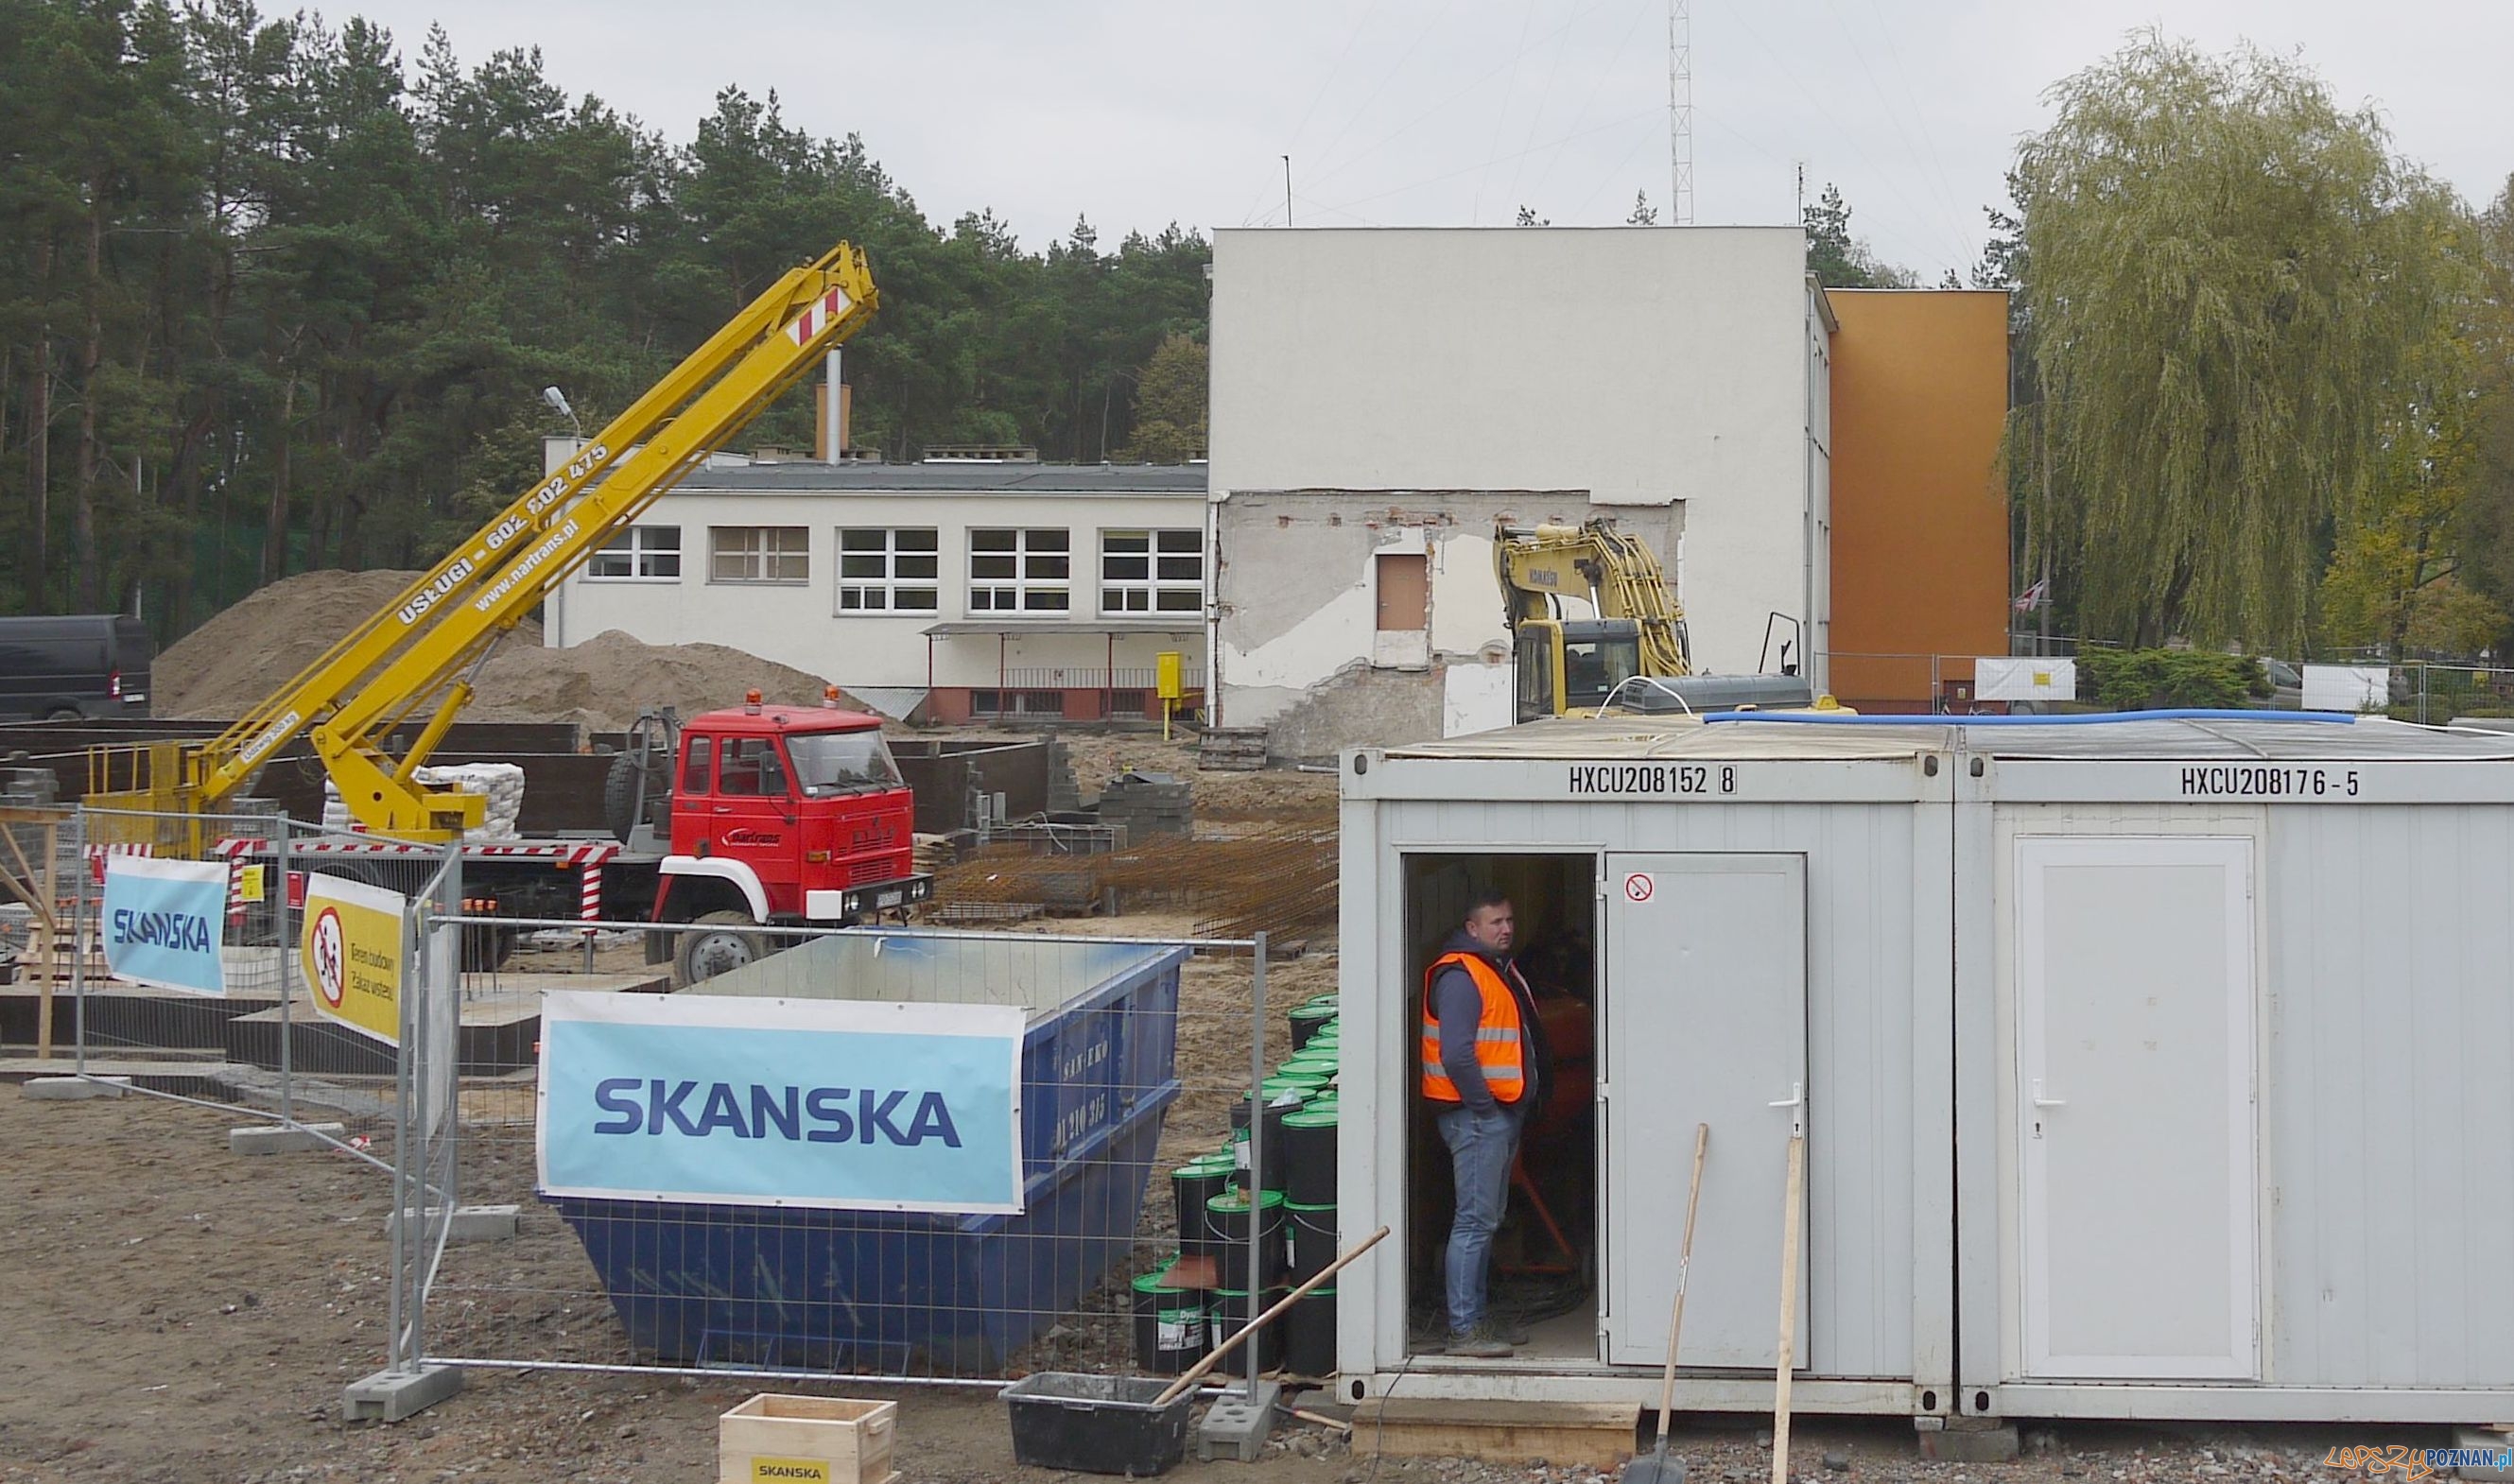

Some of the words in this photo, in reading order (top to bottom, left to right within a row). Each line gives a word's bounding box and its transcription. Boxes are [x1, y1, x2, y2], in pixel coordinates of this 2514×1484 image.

[397, 557, 474, 626] USŁUGI
[485, 513, 529, 550] 602
[526, 475, 568, 515] 802
[568, 444, 608, 480] 475
[475, 518, 580, 613] www.nartrans.pl
[1569, 766, 1708, 793] HXCU208152
[1721, 767, 1735, 793] 8
[113, 908, 211, 954] SKANSKA
[594, 1078, 962, 1148] SKANSKA
[758, 1464, 823, 1480] SKANSKA
